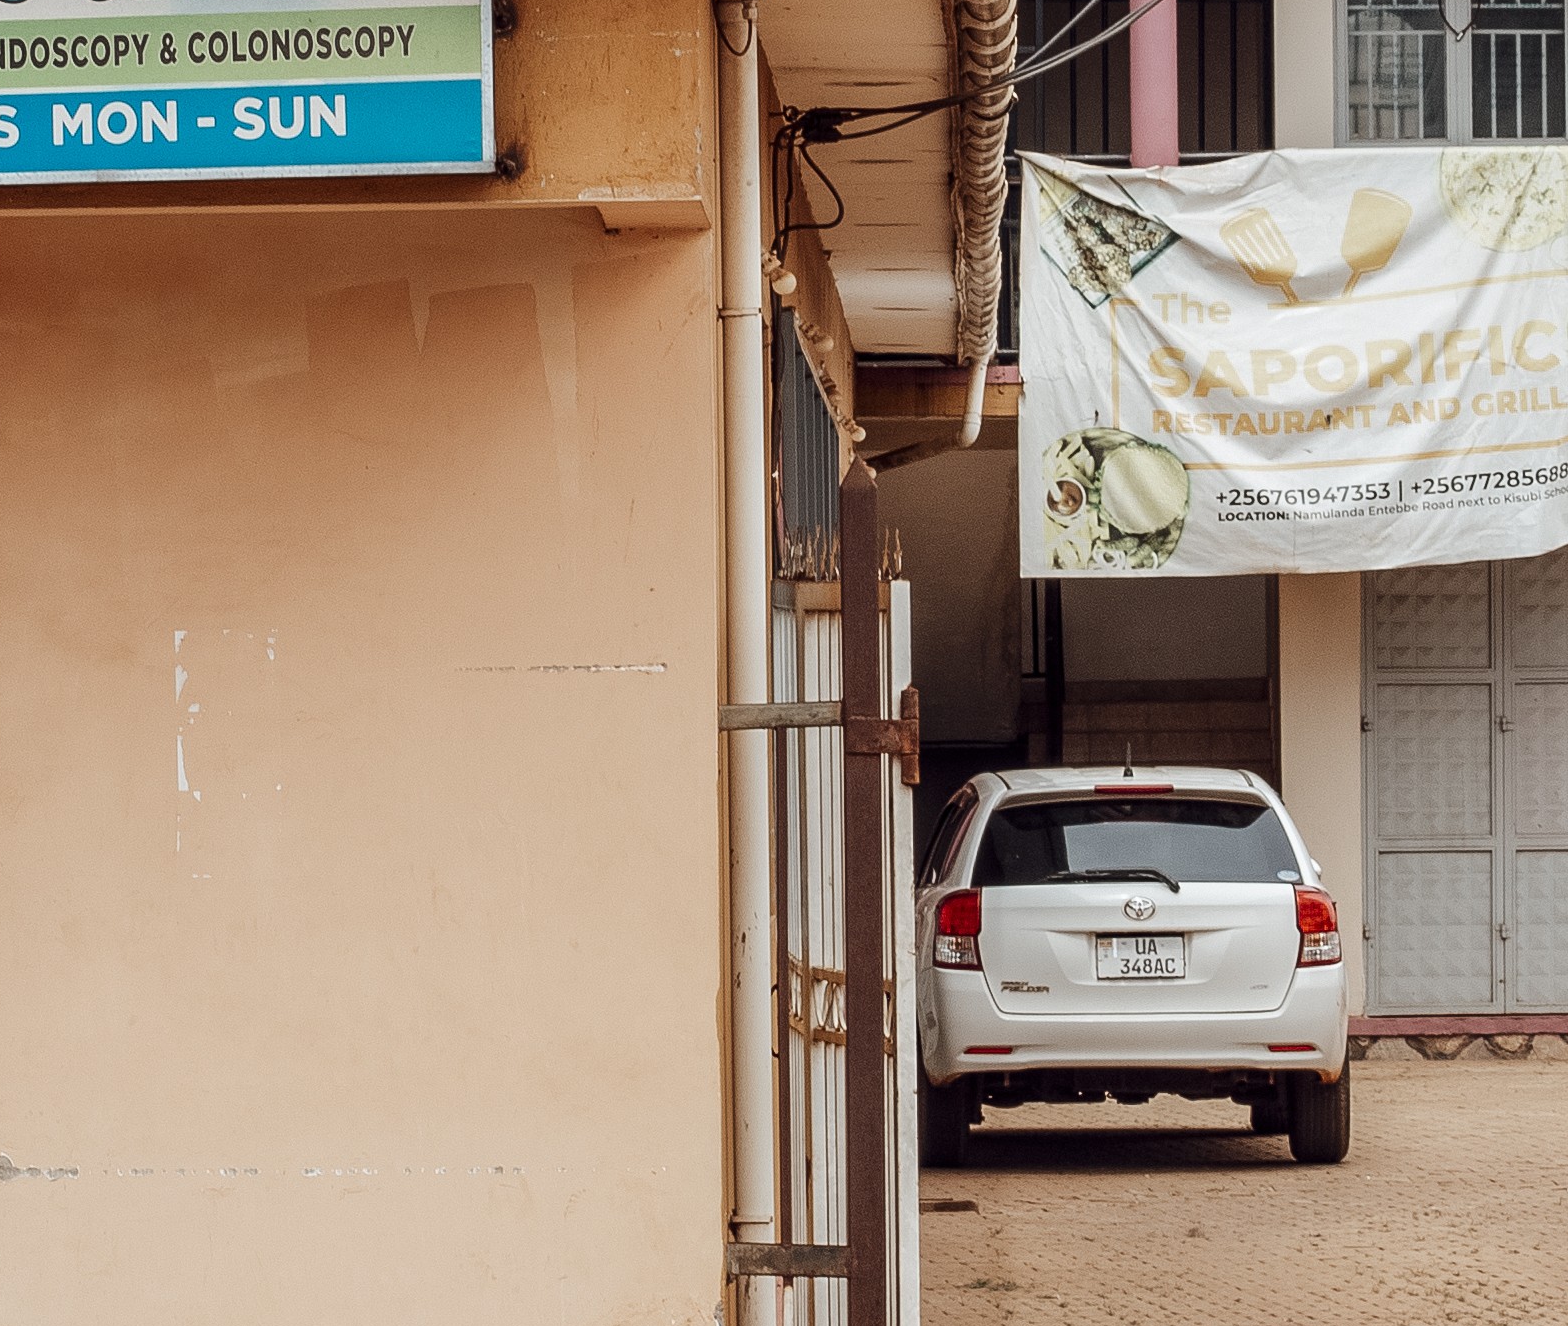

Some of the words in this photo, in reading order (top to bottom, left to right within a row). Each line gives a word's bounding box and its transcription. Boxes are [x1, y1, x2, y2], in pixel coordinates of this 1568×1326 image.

[159, 35, 177, 65] &
[188, 25, 415, 64] COLONOSCOPY
[52, 100, 178, 146] MON
[197, 116, 215, 128] -
[233, 94, 347, 141] SUN
[1151, 292, 1232, 324] The
[1148, 318, 1561, 400] SAPORIFIC
[1152, 404, 1376, 436] RESTAURANT
[1387, 396, 1460, 427] AND
[1471, 386, 1568, 417] GRILL
[1216, 482, 1391, 507] +256761947353
[1218, 510, 1291, 522] LOCATION:
[1293, 506, 1365, 522] Namulanda
[1368, 501, 1419, 517] Entebbe
[1422, 498, 1454, 512] Road
[1457, 496, 1485, 508] next
[1488, 494, 1501, 506] to
[1504, 489, 1543, 505] Kisubi
[1135, 938, 1158, 955] UA
[1120, 958, 1176, 975] 348AC
